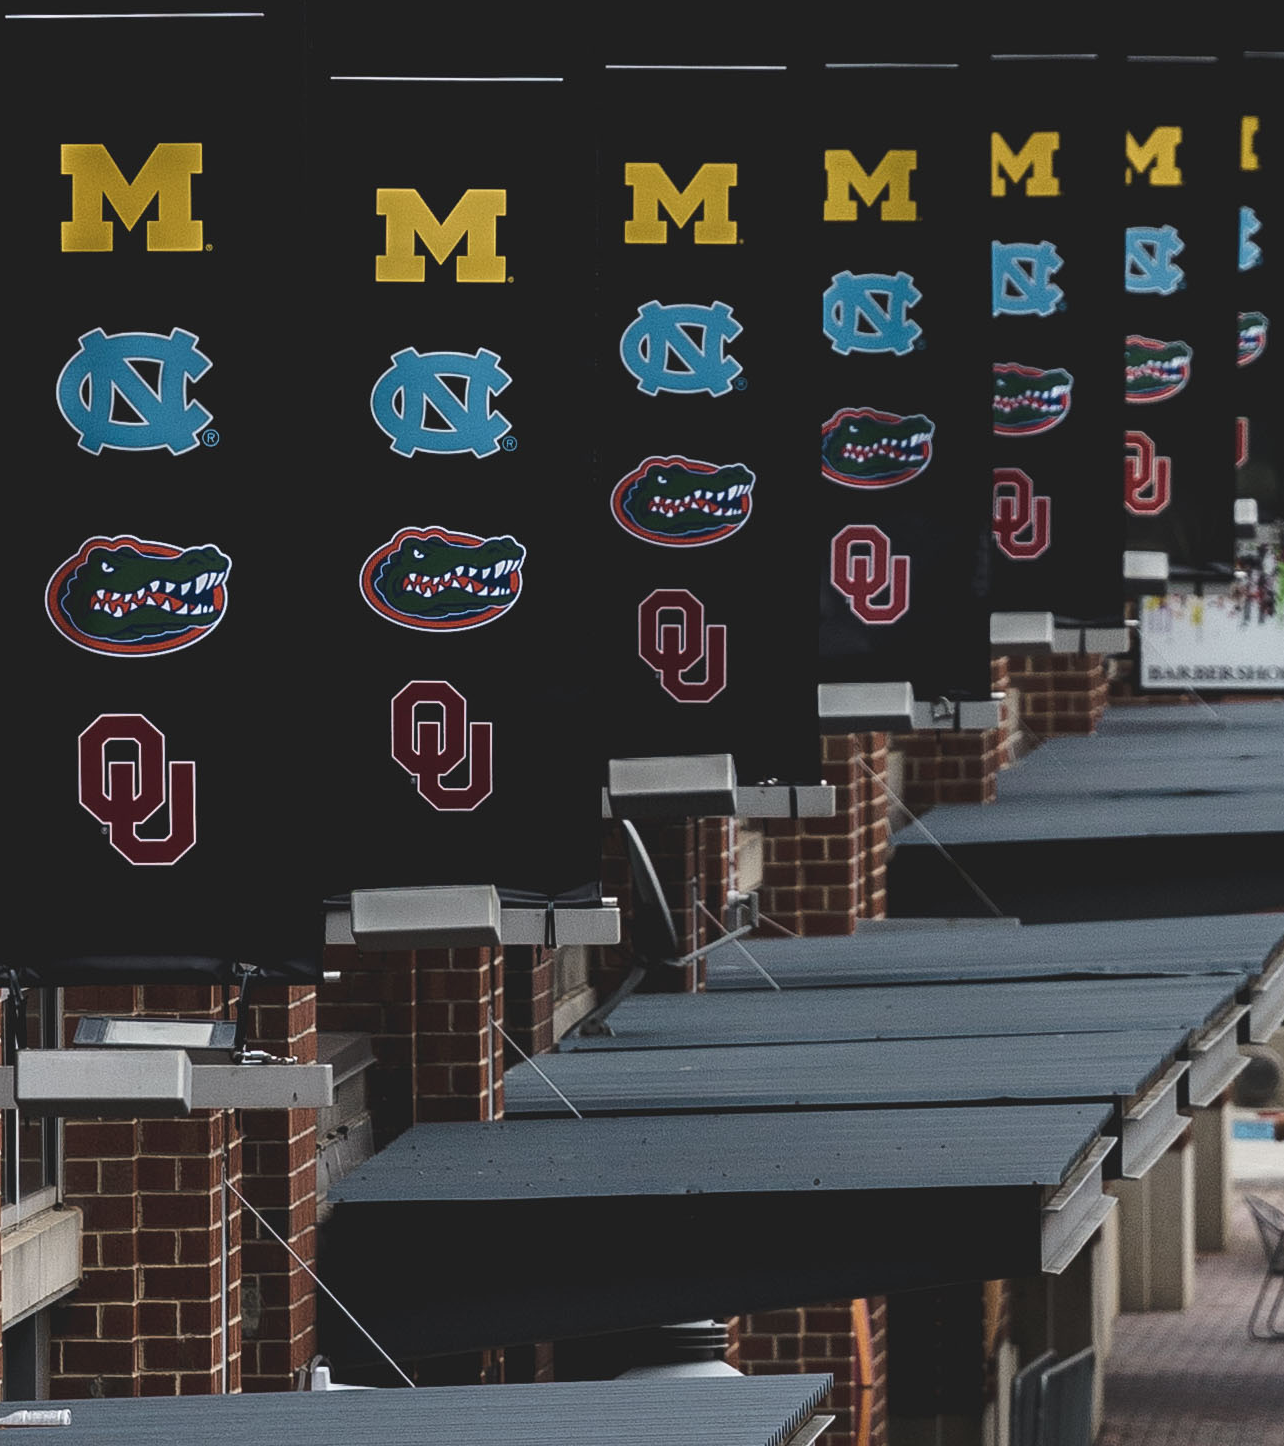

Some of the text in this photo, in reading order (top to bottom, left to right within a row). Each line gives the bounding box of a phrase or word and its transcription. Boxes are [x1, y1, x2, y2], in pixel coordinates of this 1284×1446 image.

[60, 143, 203, 252] M
[624, 162, 738, 244] M
[823, 149, 917, 222] M
[991, 131, 1060, 197] M
[375, 188, 507, 283] M
[830, 524, 911, 624] OU
[638, 588, 727, 703] OU
[78, 713, 197, 866] OU
[391, 680, 493, 812] OU
